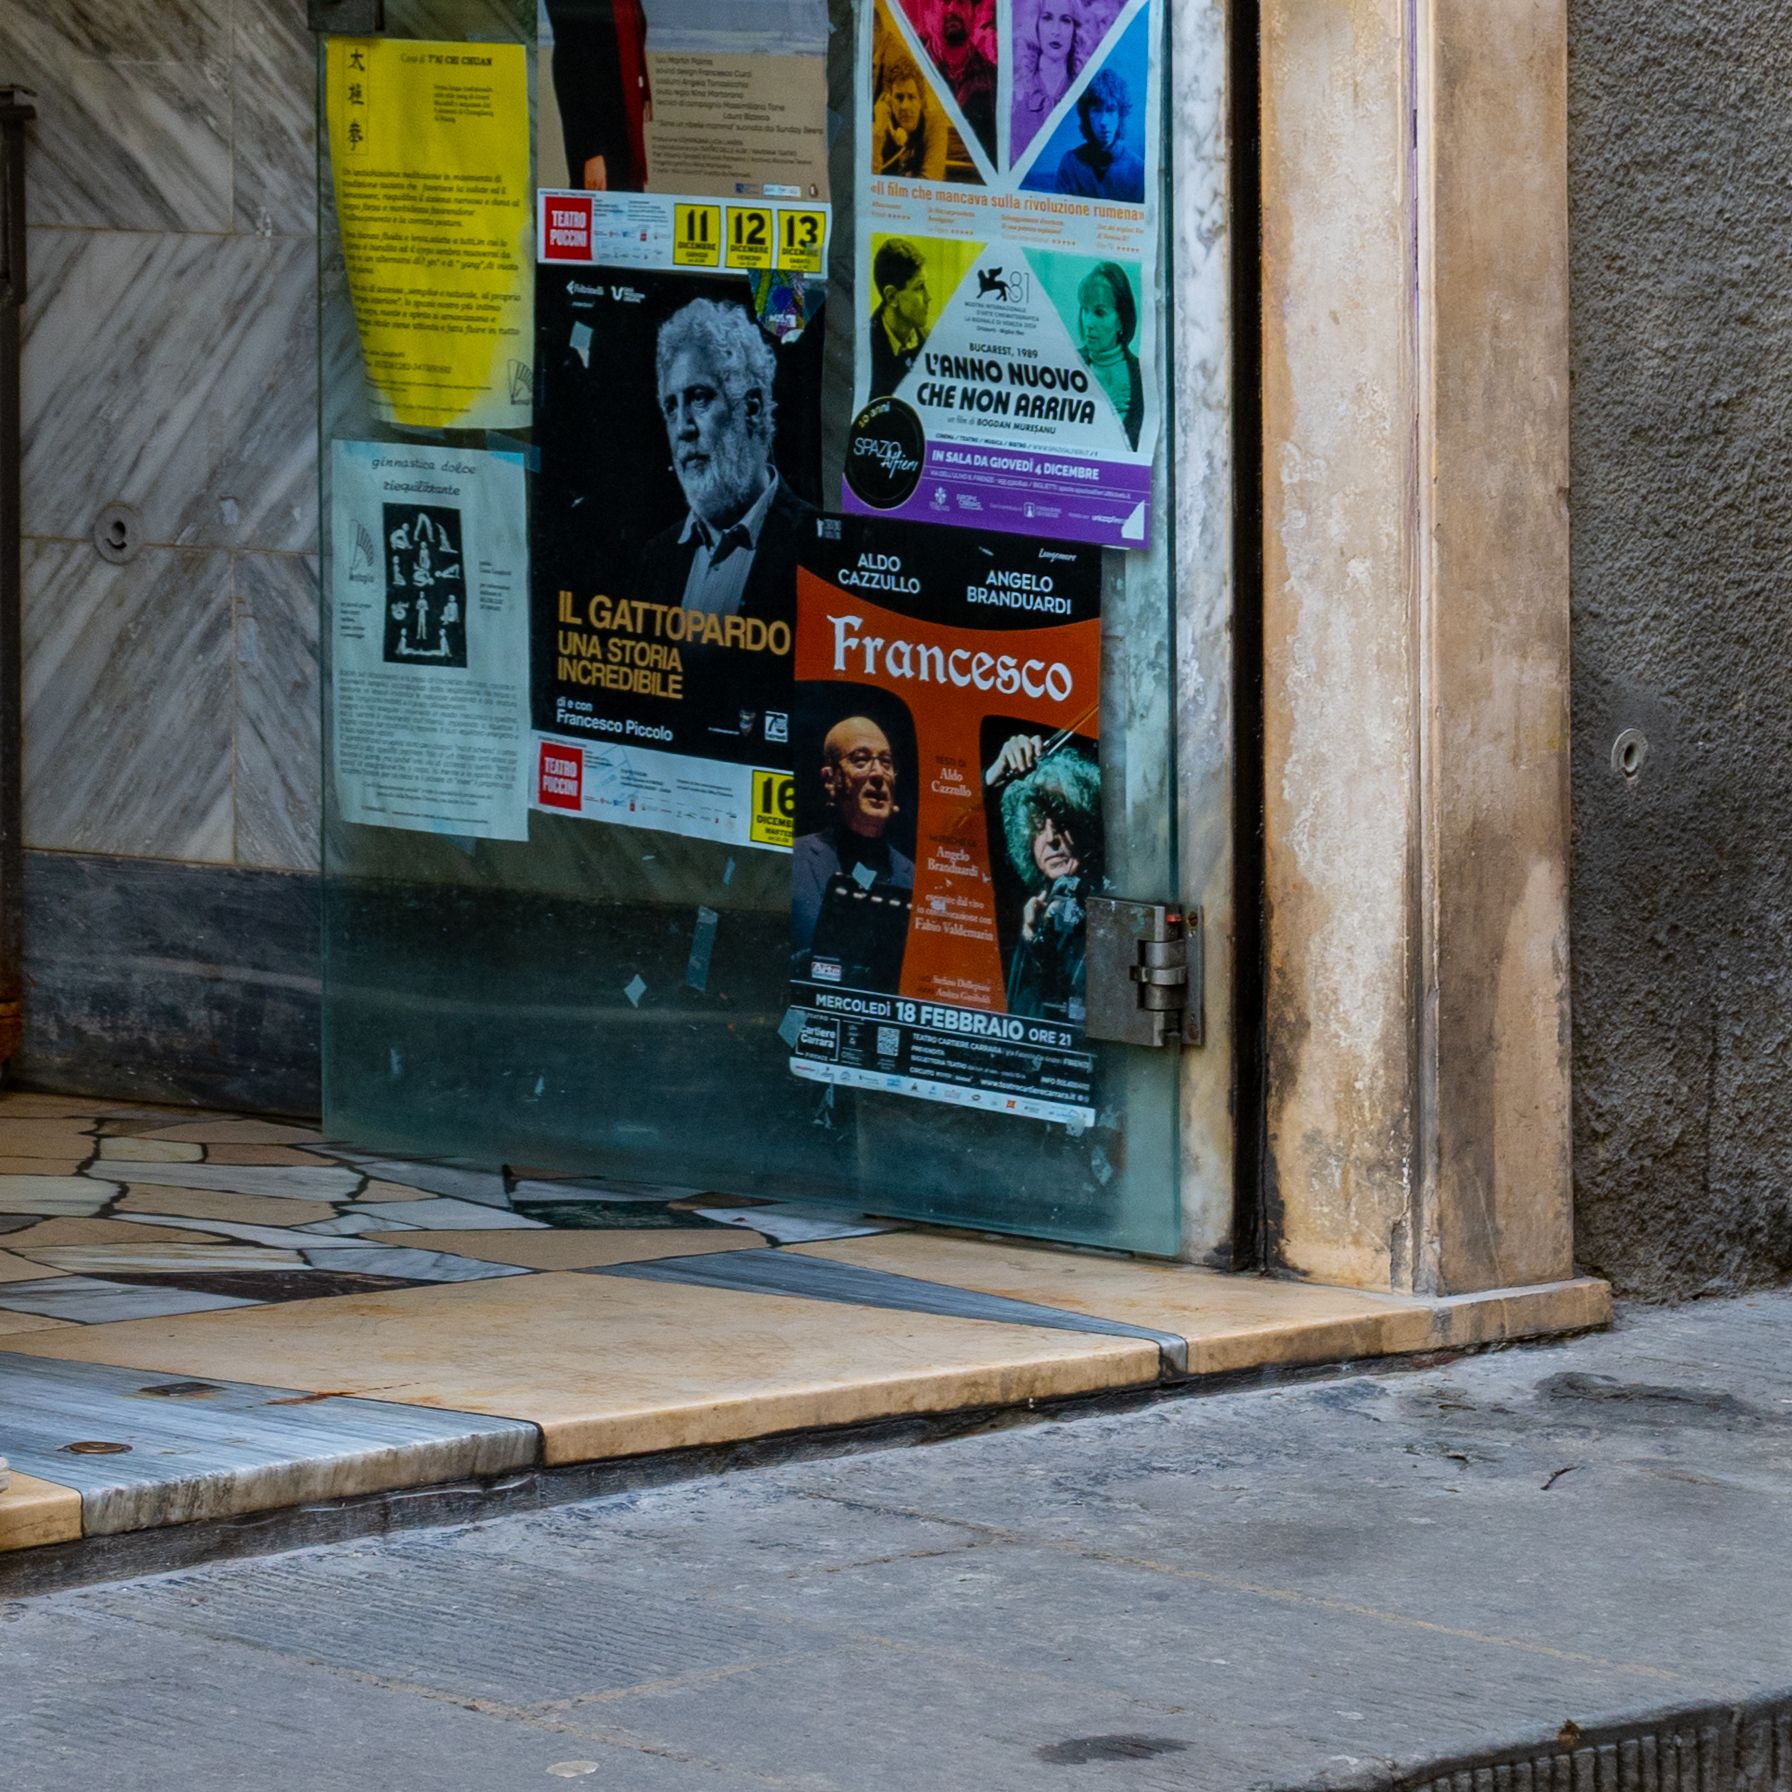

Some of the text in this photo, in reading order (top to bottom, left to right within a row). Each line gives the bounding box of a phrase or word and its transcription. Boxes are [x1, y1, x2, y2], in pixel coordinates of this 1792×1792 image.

[445, 56, 459, 65] CHI
[460, 56, 493, 66] CHUAN
[551, 209, 586, 228] TEATRO
[687, 209, 708, 242] 11
[734, 212, 766, 245] 12
[786, 215, 818, 248] 13
[924, 352, 1089, 393] L'ANNO NUOVO
[916, 382, 1096, 425] CHE NON ARRIVA
[858, 552, 901, 572] ALDO
[838, 569, 921, 594] CAZZULLO
[985, 570, 1053, 592] ANGELO
[967, 586, 1072, 615] BRANDUARDI
[558, 590, 791, 656] IL GATTOPARDO
[558, 630, 683, 673] UNA STORIA
[826, 614, 1073, 702] Francesco
[558, 656, 684, 700] INCREDIBILE
[556, 709, 673, 742] Francesco Piccolo
[544, 756, 577, 778] TEATRO
[939, 768, 963, 782] Aldo
[542, 777, 578, 797] PUCCINI
[931, 781, 972, 797] Cazzullo
[936, 846, 970, 862] Angelo
[927, 859, 978, 878] Branduardi
[815, 993, 1072, 1046] MERCOLEDÌ 18 FEBBRAIO ORE 21
